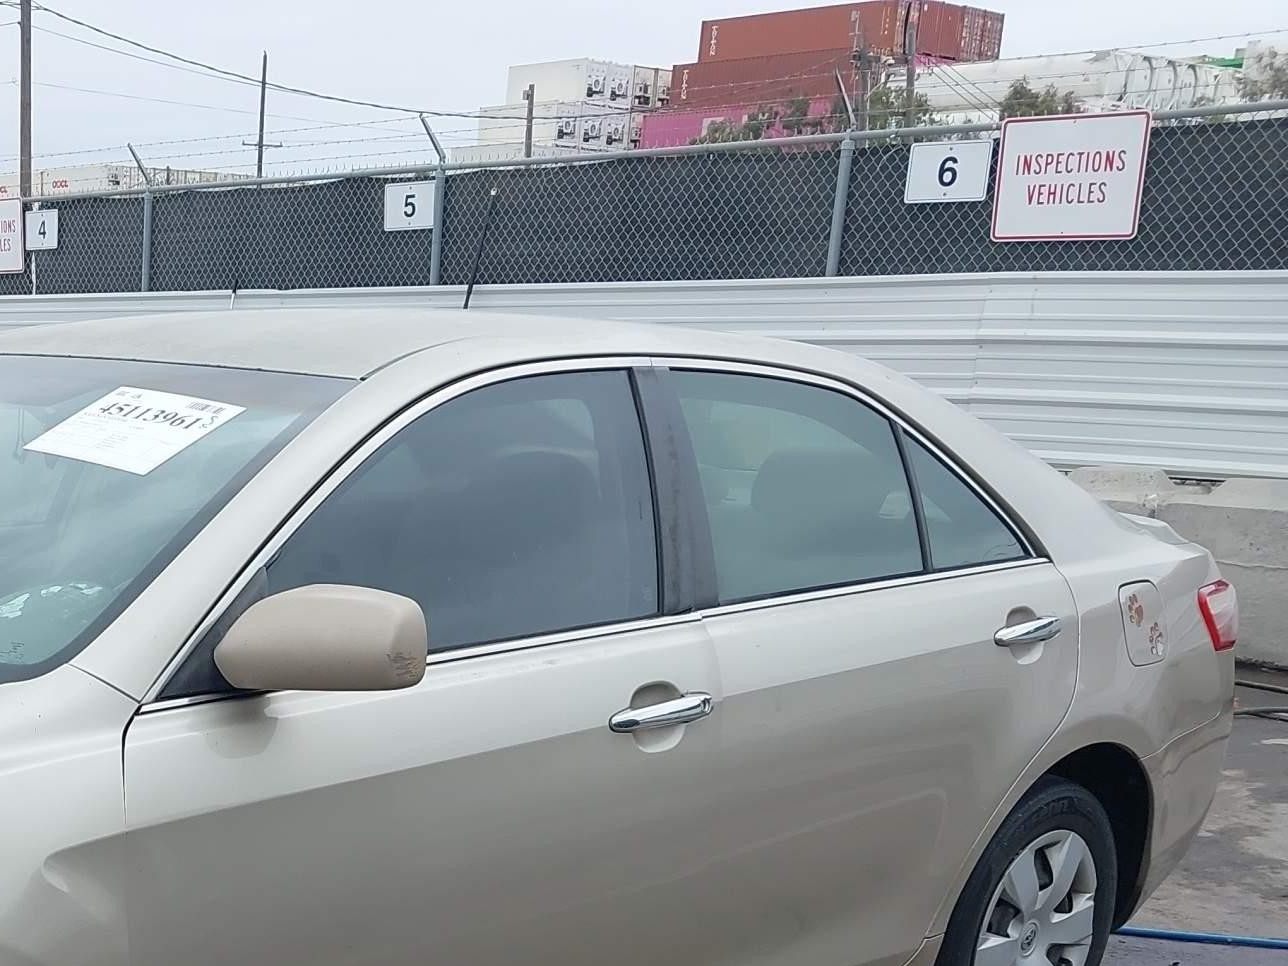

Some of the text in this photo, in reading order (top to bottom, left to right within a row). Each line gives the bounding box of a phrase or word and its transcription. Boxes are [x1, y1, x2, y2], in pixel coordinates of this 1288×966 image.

[938, 156, 959, 187] 6
[1015, 149, 1128, 176] INSPECTIONS
[404, 194, 416, 218] 5
[1027, 182, 1108, 206] VEHICLES
[38, 220, 47, 239] 4
